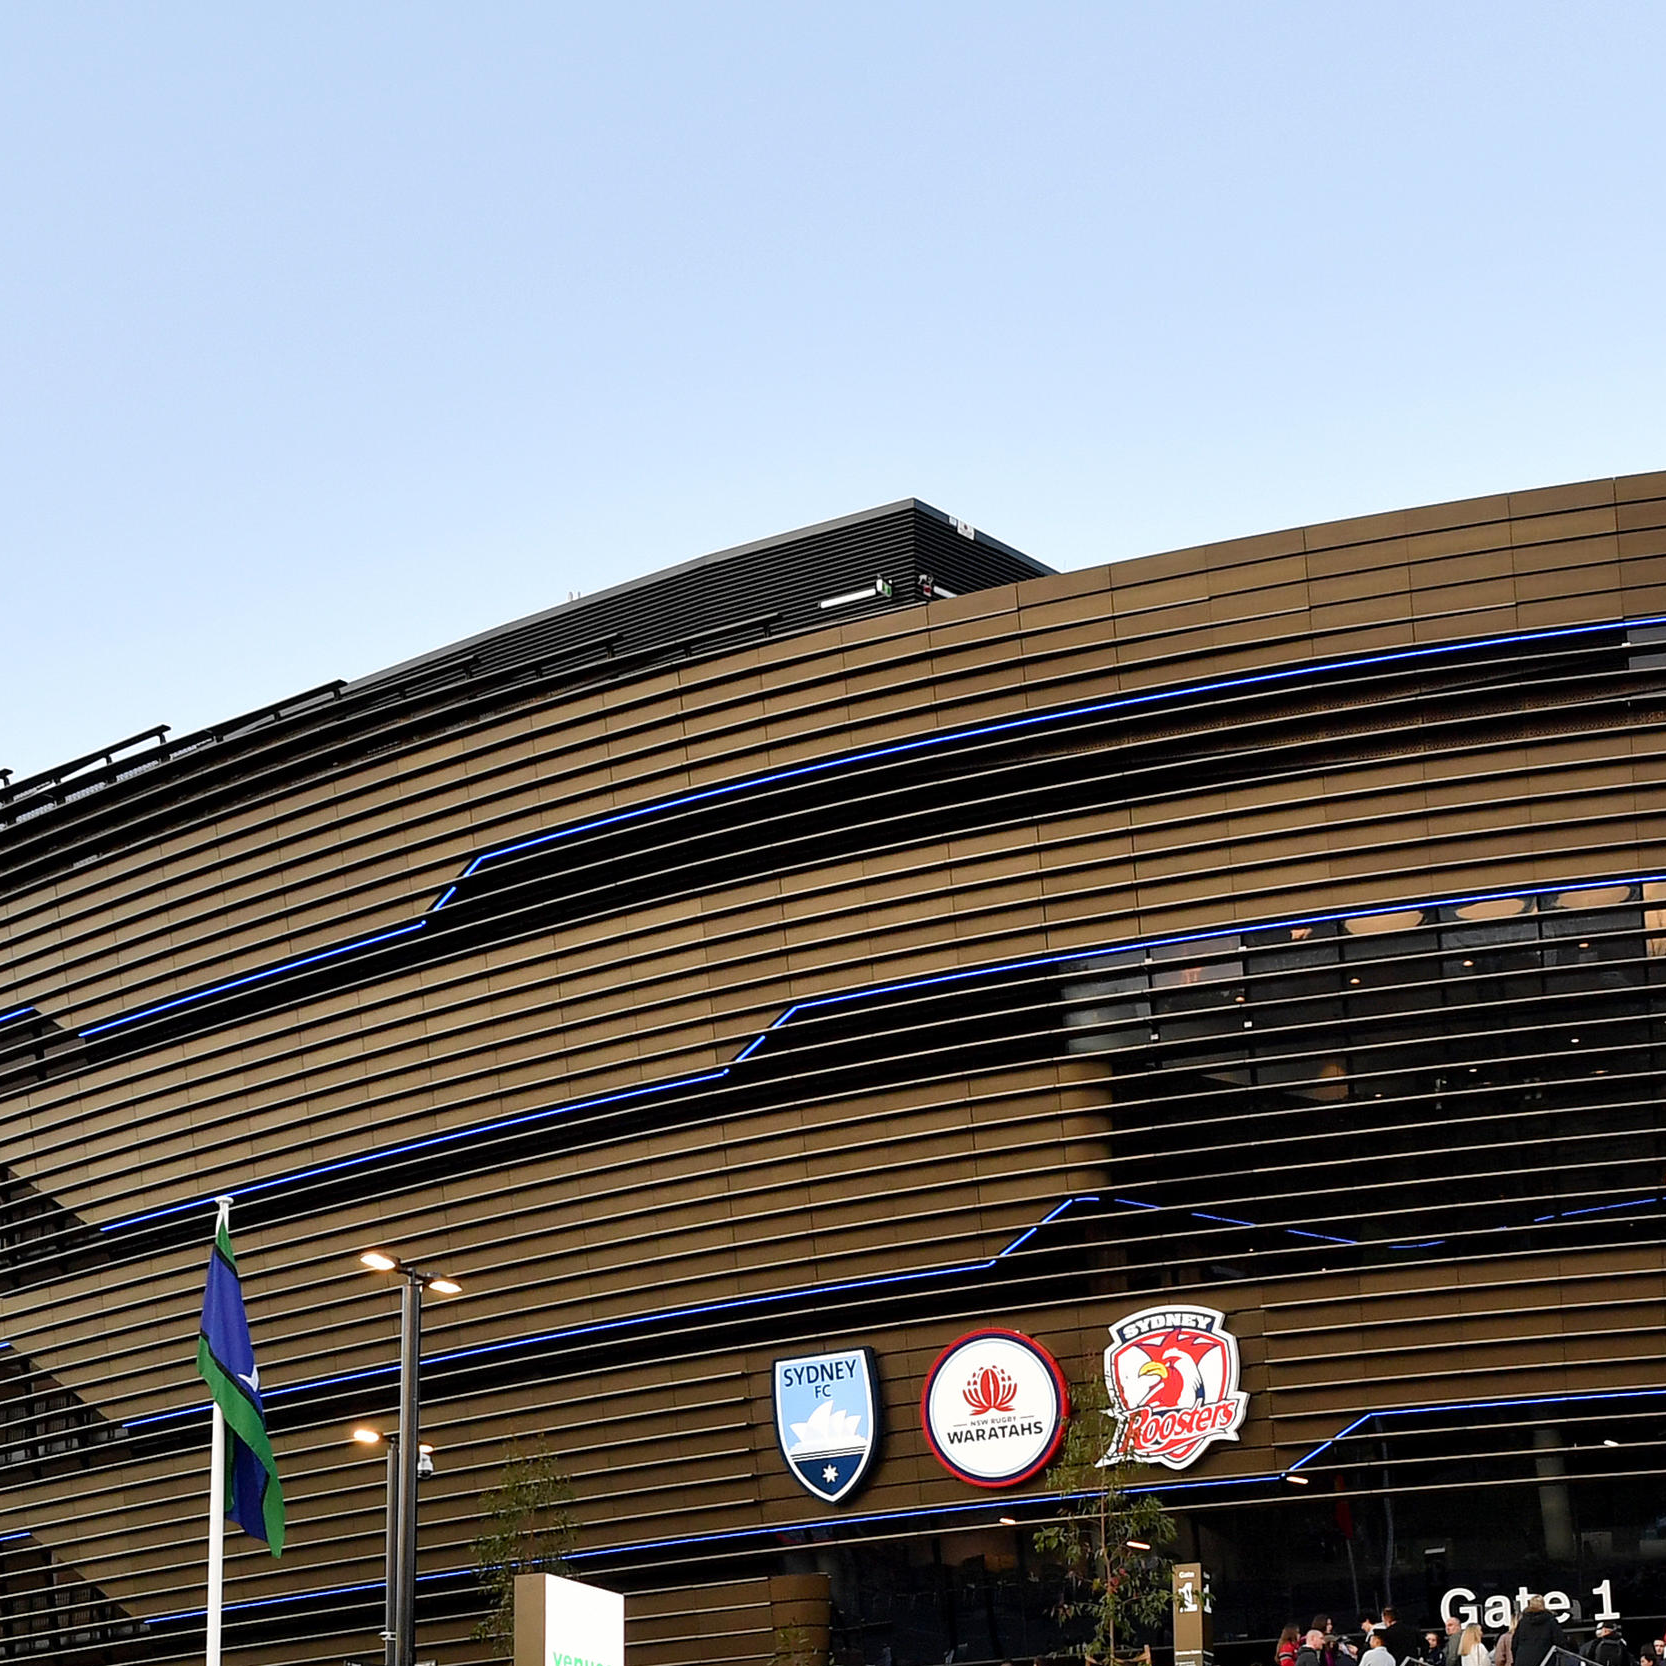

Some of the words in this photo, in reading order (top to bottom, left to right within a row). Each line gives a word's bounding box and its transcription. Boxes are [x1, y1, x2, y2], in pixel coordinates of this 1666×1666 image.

[1122, 1313, 1213, 1339] SYDNEY
[783, 1359, 856, 1387] SYDNEY
[814, 1384, 831, 1398] FC
[947, 1421, 1044, 1445] WARATAHS
[970, 1418, 988, 1426] NSW
[991, 1416, 1017, 1424] RUGBY
[1118, 1401, 1236, 1452] Roosters
[1440, 1586, 1571, 1630] Gate
[1592, 1579, 1621, 1621] 1
